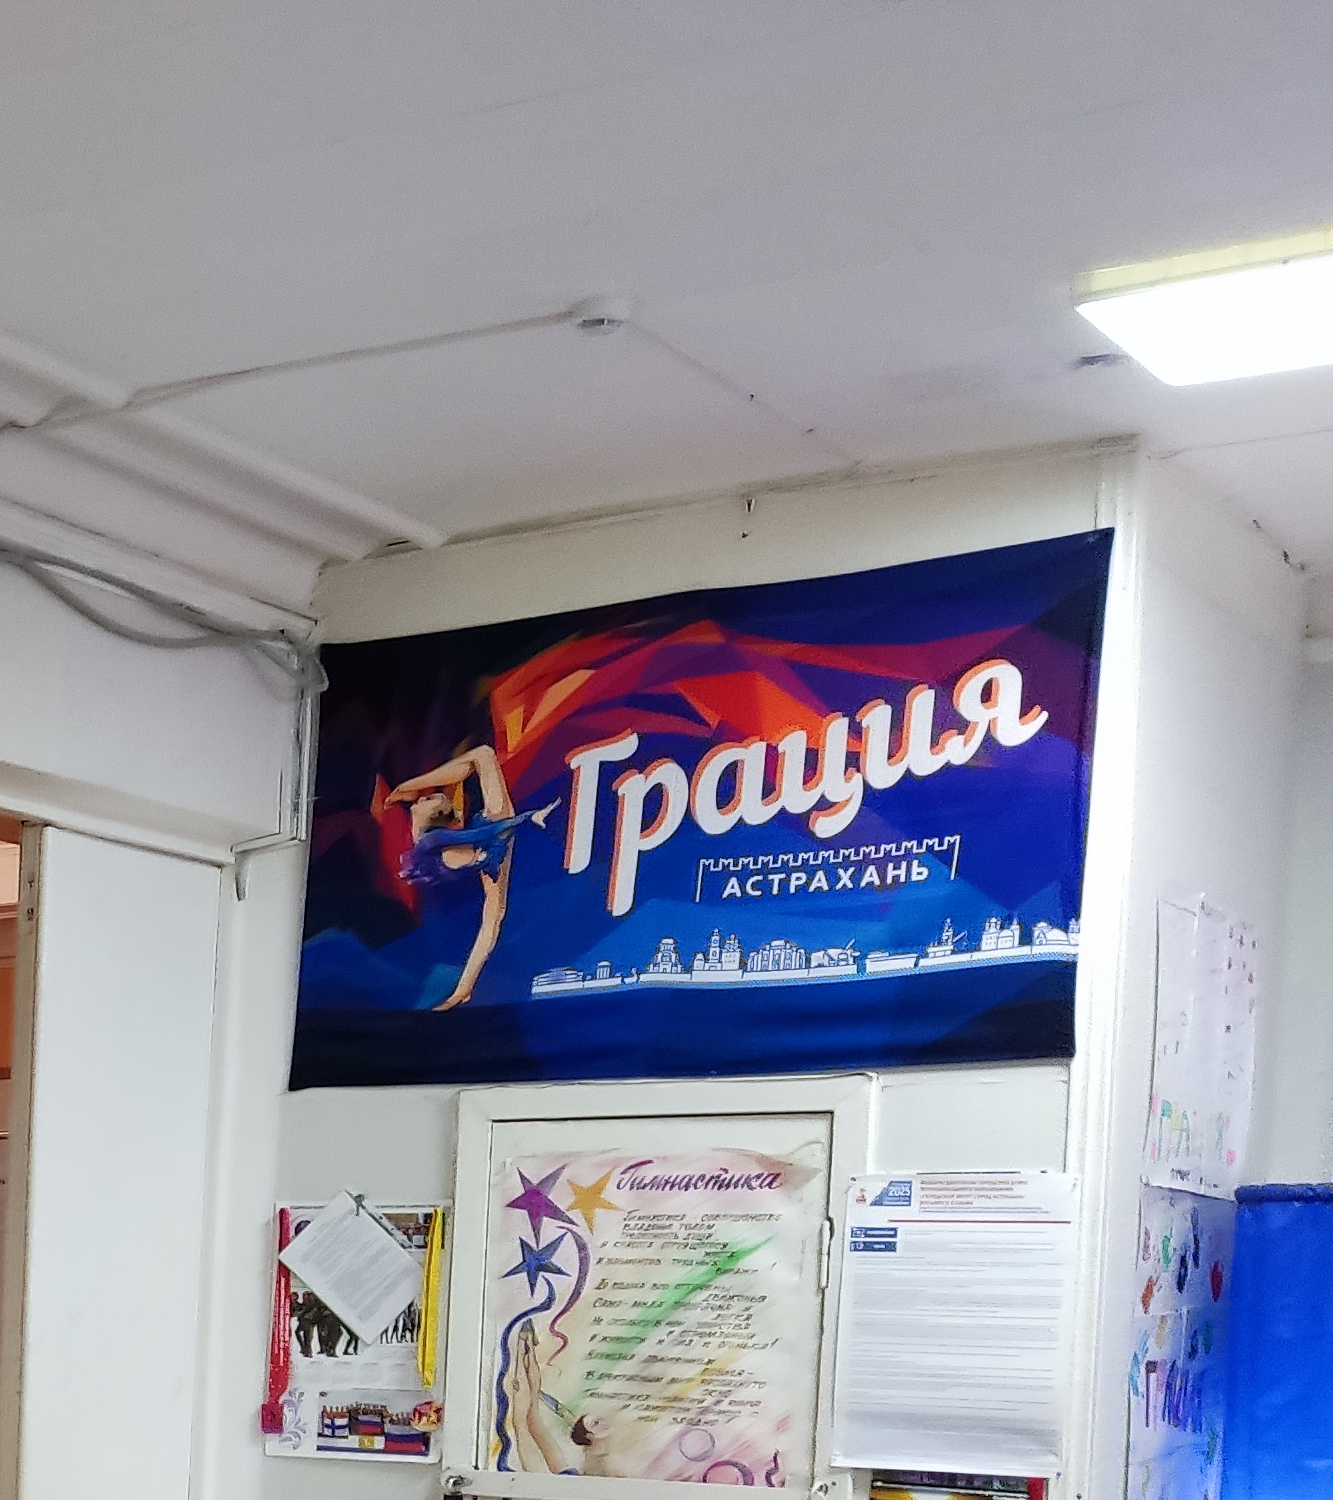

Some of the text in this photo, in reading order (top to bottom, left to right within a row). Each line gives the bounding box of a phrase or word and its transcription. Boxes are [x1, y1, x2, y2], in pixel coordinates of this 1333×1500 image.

[563, 658, 1049, 918] Грация
[721, 861, 931, 900] АСТРАХАНЬ
[616, 1159, 783, 1193] Гимнастика
